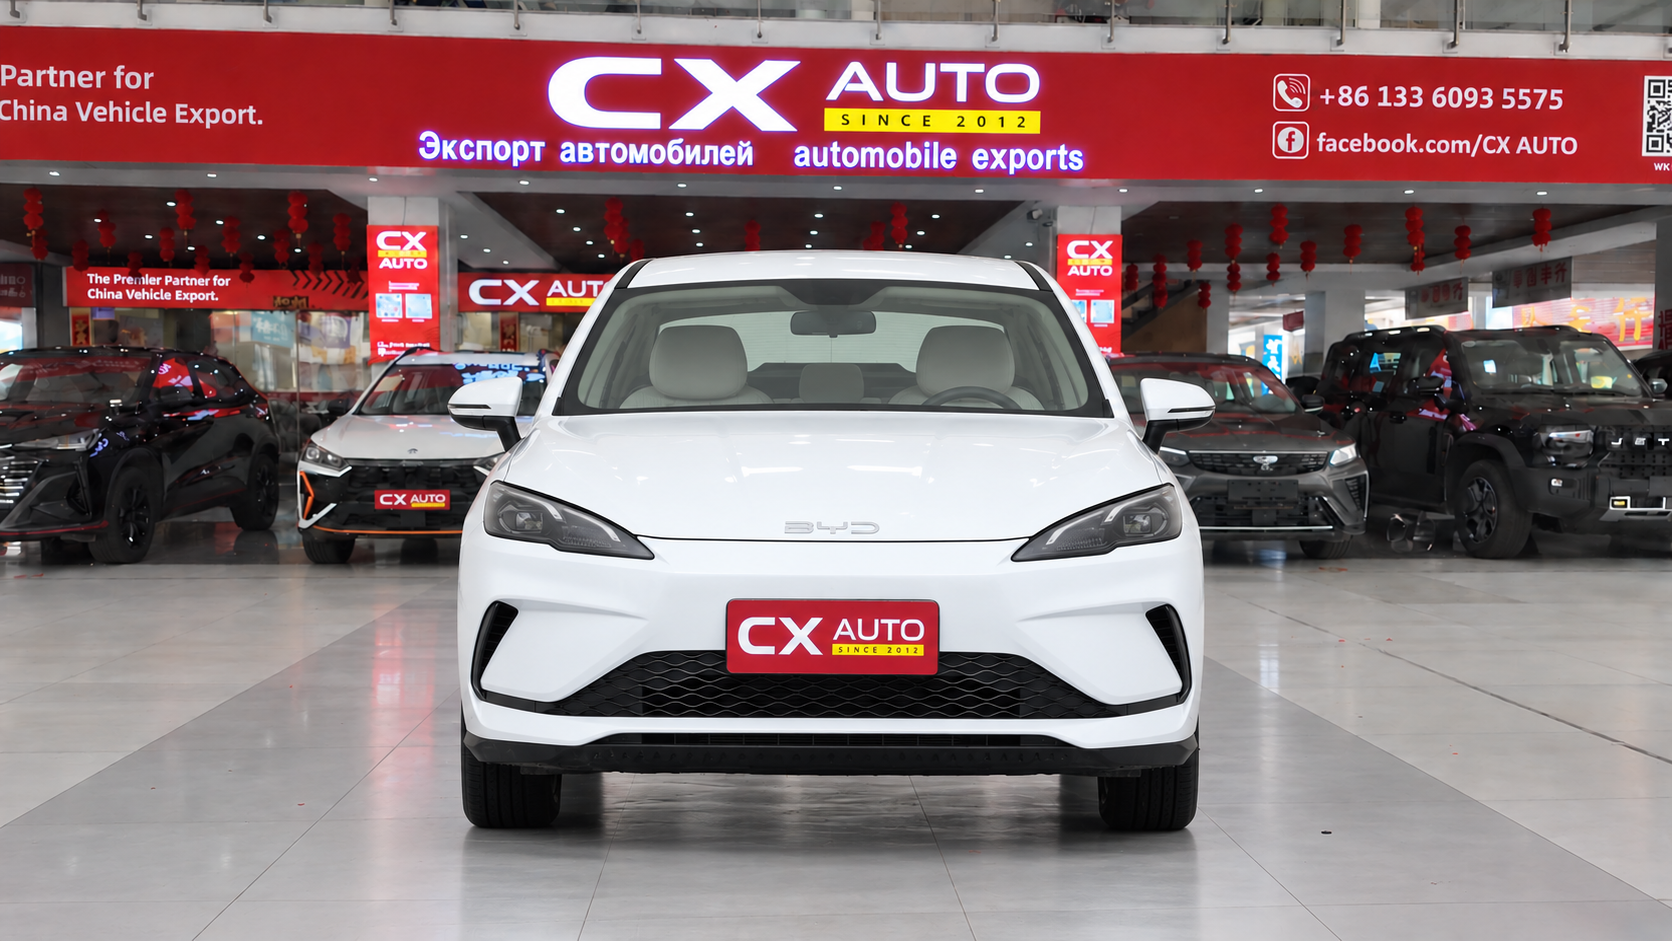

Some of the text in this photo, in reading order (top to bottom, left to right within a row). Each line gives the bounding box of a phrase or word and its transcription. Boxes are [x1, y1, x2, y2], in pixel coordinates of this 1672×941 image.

[0, 64, 154, 89] Partner for
[547, 56, 1041, 132] CX AUTO
[1319, 85, 1563, 110] +86 133 6093 5575
[0, 99, 263, 129] China Vehicle Export.
[841, 114, 1026, 128] SINCE 2012
[418, 130, 754, 167] Экспорт автомобилей
[1316, 132, 1578, 157] facebook.com/CX AUTO
[793, 141, 1085, 175] automobile exports
[376, 230, 427, 251] CX
[1066, 240, 1113, 259] CX
[378, 258, 428, 269] AUTO
[1067, 265, 1113, 276] AUTO
[87, 273, 110, 285] The
[165, 275, 210, 286] Partner
[212, 275, 231, 287] for
[87, 288, 219, 303] China Vehicle Export.
[468, 278, 608, 306] CX AUT
[379, 493, 446, 505] CX AUTO
[784, 520, 880, 535] BYD
[737, 617, 925, 655] CX AUTO
[838, 646, 878, 654] SINCE
